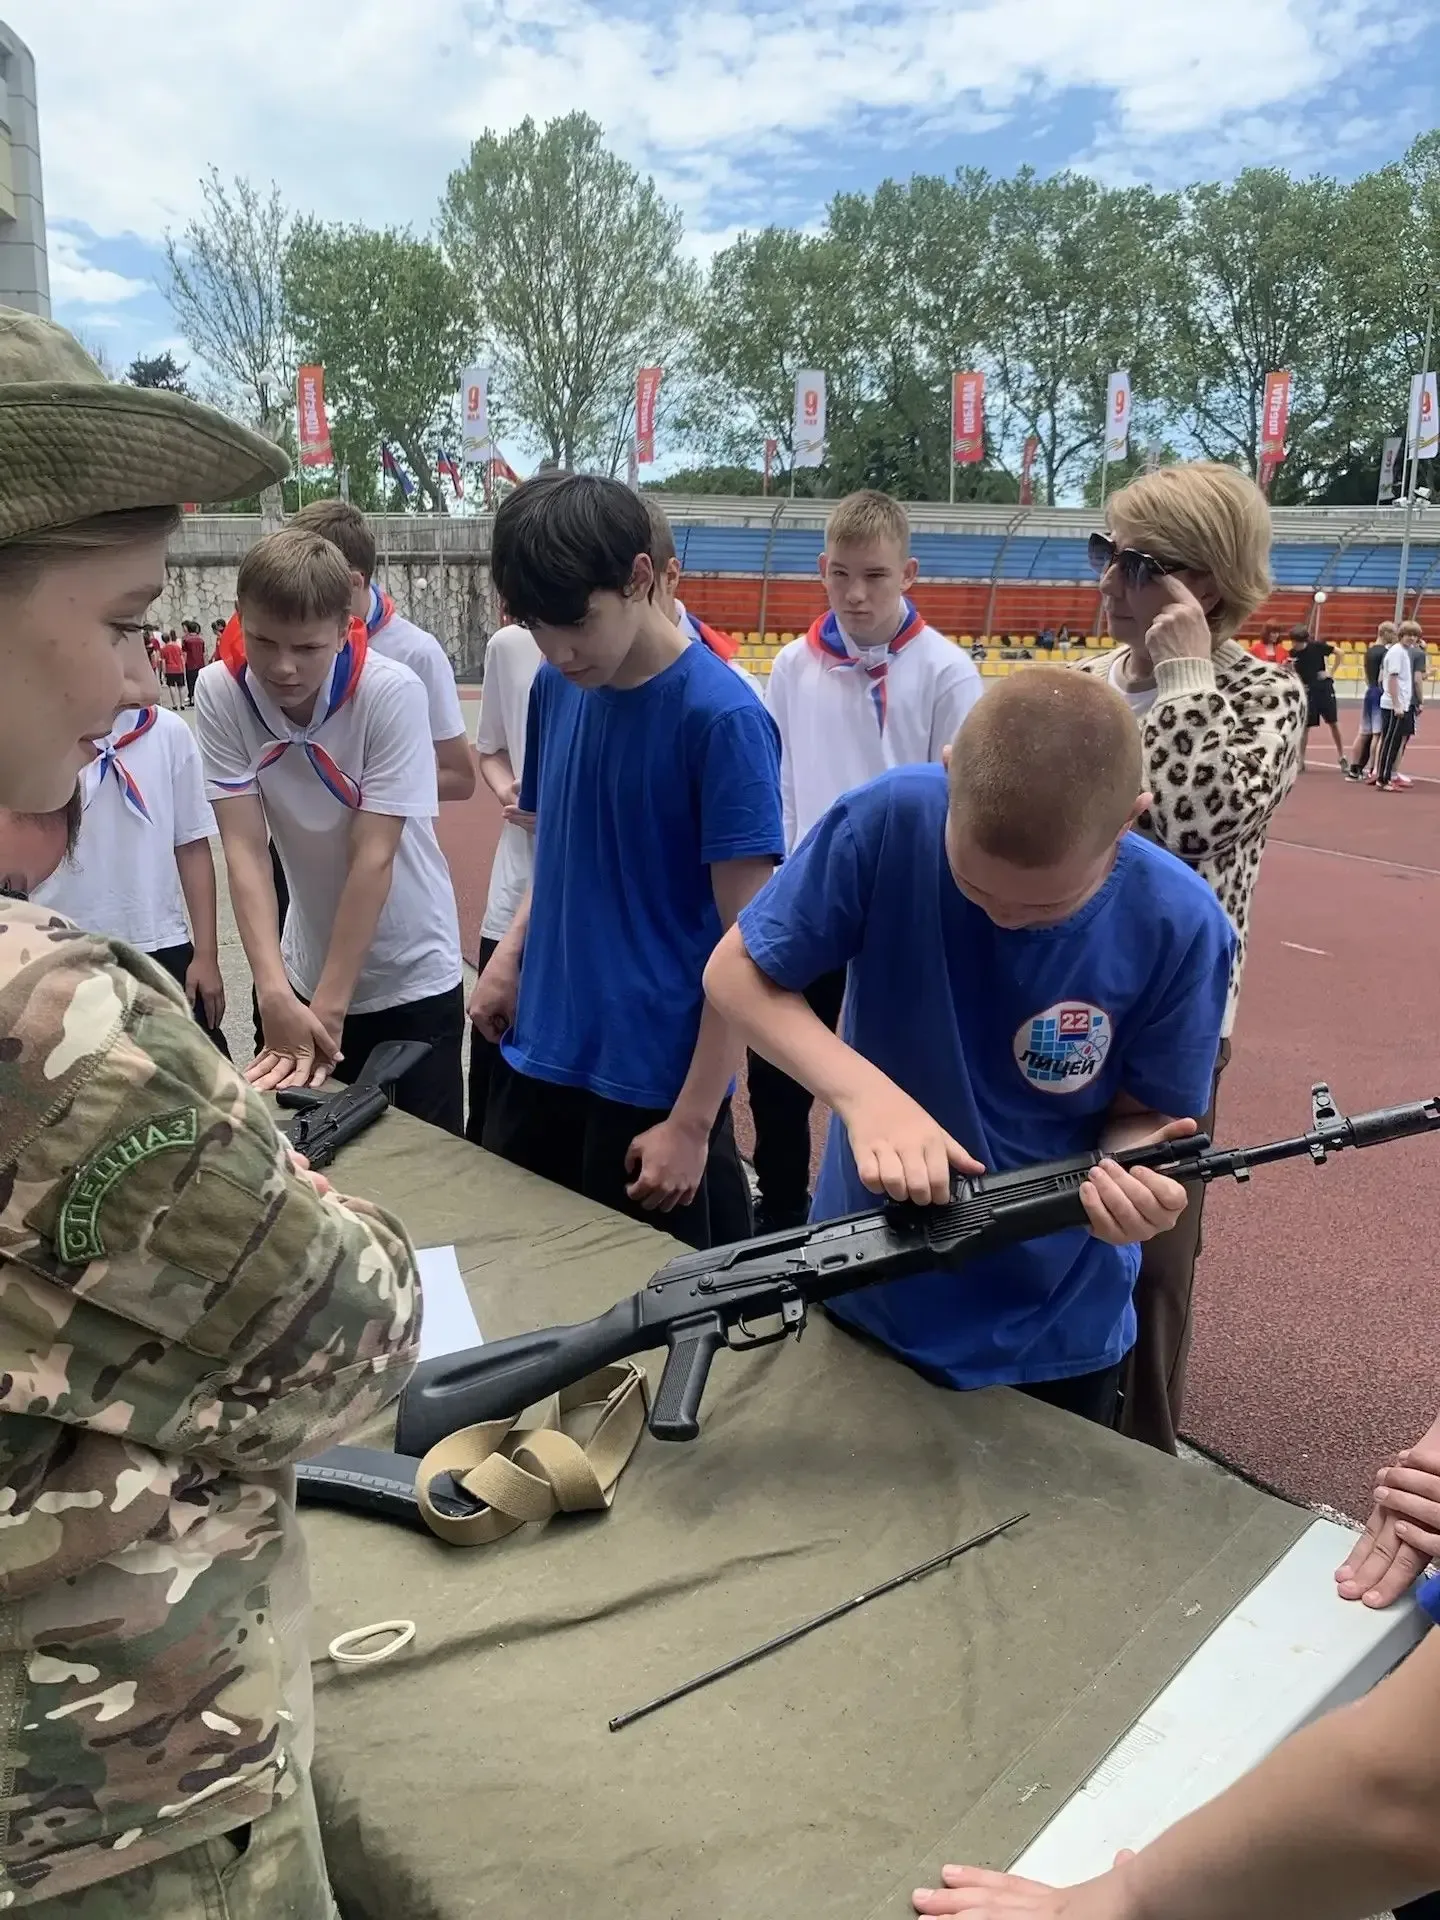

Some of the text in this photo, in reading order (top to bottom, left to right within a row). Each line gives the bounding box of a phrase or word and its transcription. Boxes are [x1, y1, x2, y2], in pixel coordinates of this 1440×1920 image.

[303, 377, 320, 434] ПОБЕДА!
[468, 386, 480, 412] 9
[804, 390, 818, 416] 9
[962, 380, 977, 434] ПОБЕДА!
[1115, 390, 1125, 414] 9
[1269, 383, 1284, 435] ПОБЕДА!
[1421, 391, 1431, 414] 9
[1060, 1012, 1089, 1030] 22
[1018, 1050, 1096, 1078] ЛИЦЕЙ
[66, 1118, 189, 1250] СПЕЦНАЗ
